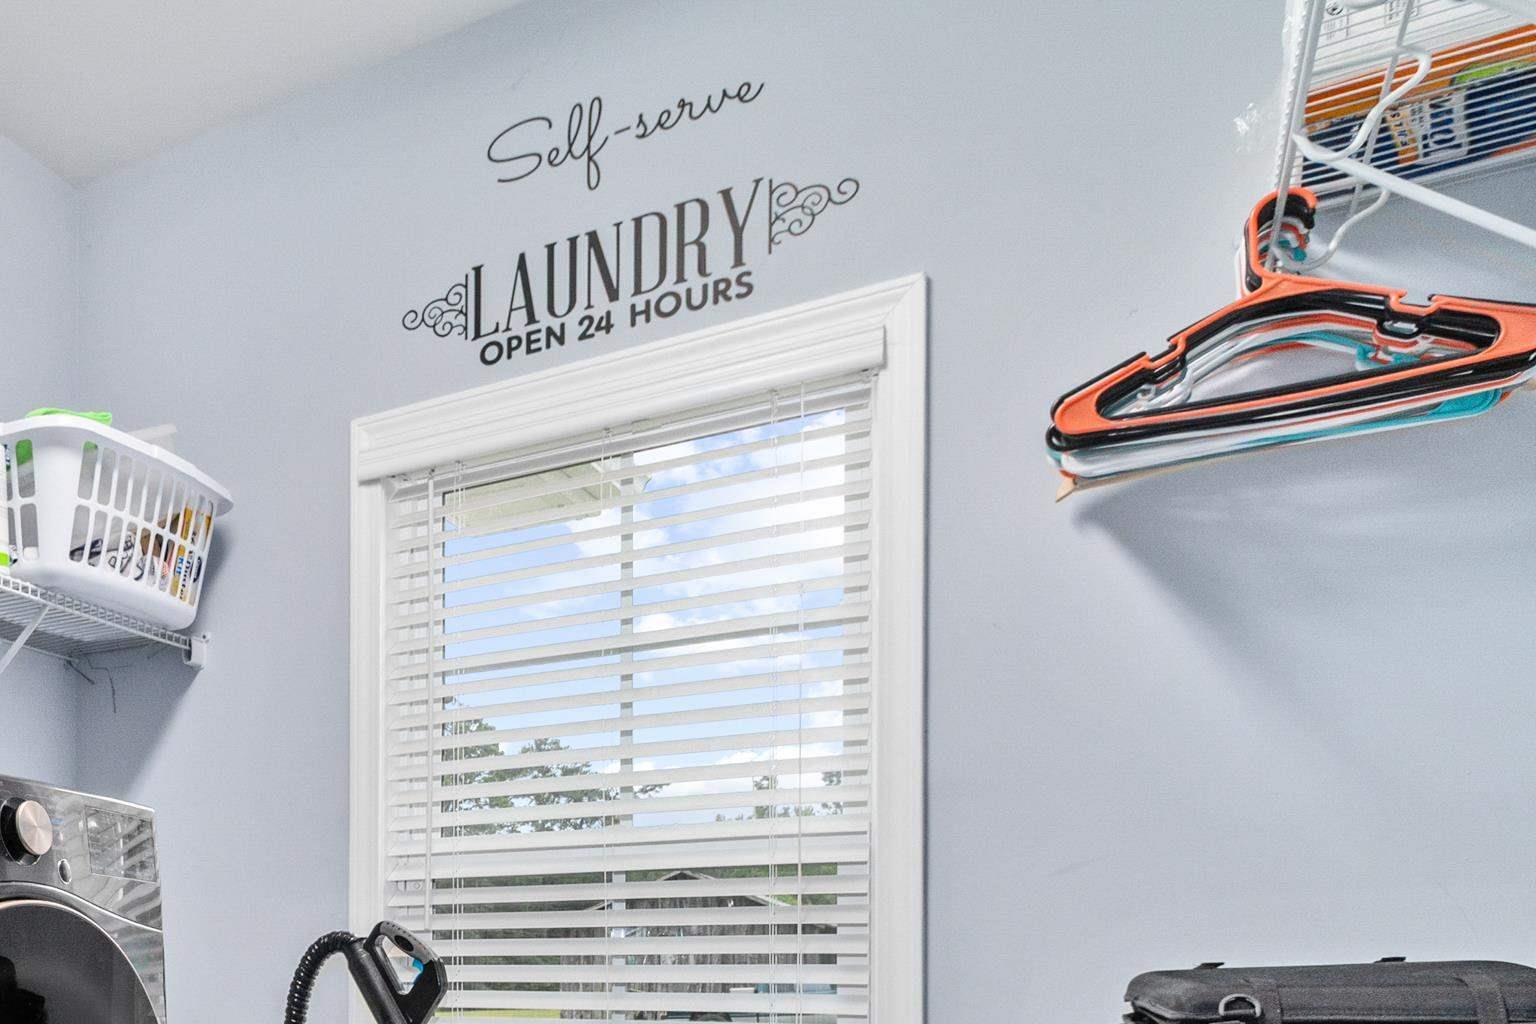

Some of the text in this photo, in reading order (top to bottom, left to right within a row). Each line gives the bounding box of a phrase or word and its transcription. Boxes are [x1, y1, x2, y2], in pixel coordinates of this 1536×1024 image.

[486, 81, 765, 191] Self-serve
[470, 177, 764, 342] LAUNDRY
[479, 271, 754, 367] OPEN 24 HOURS
